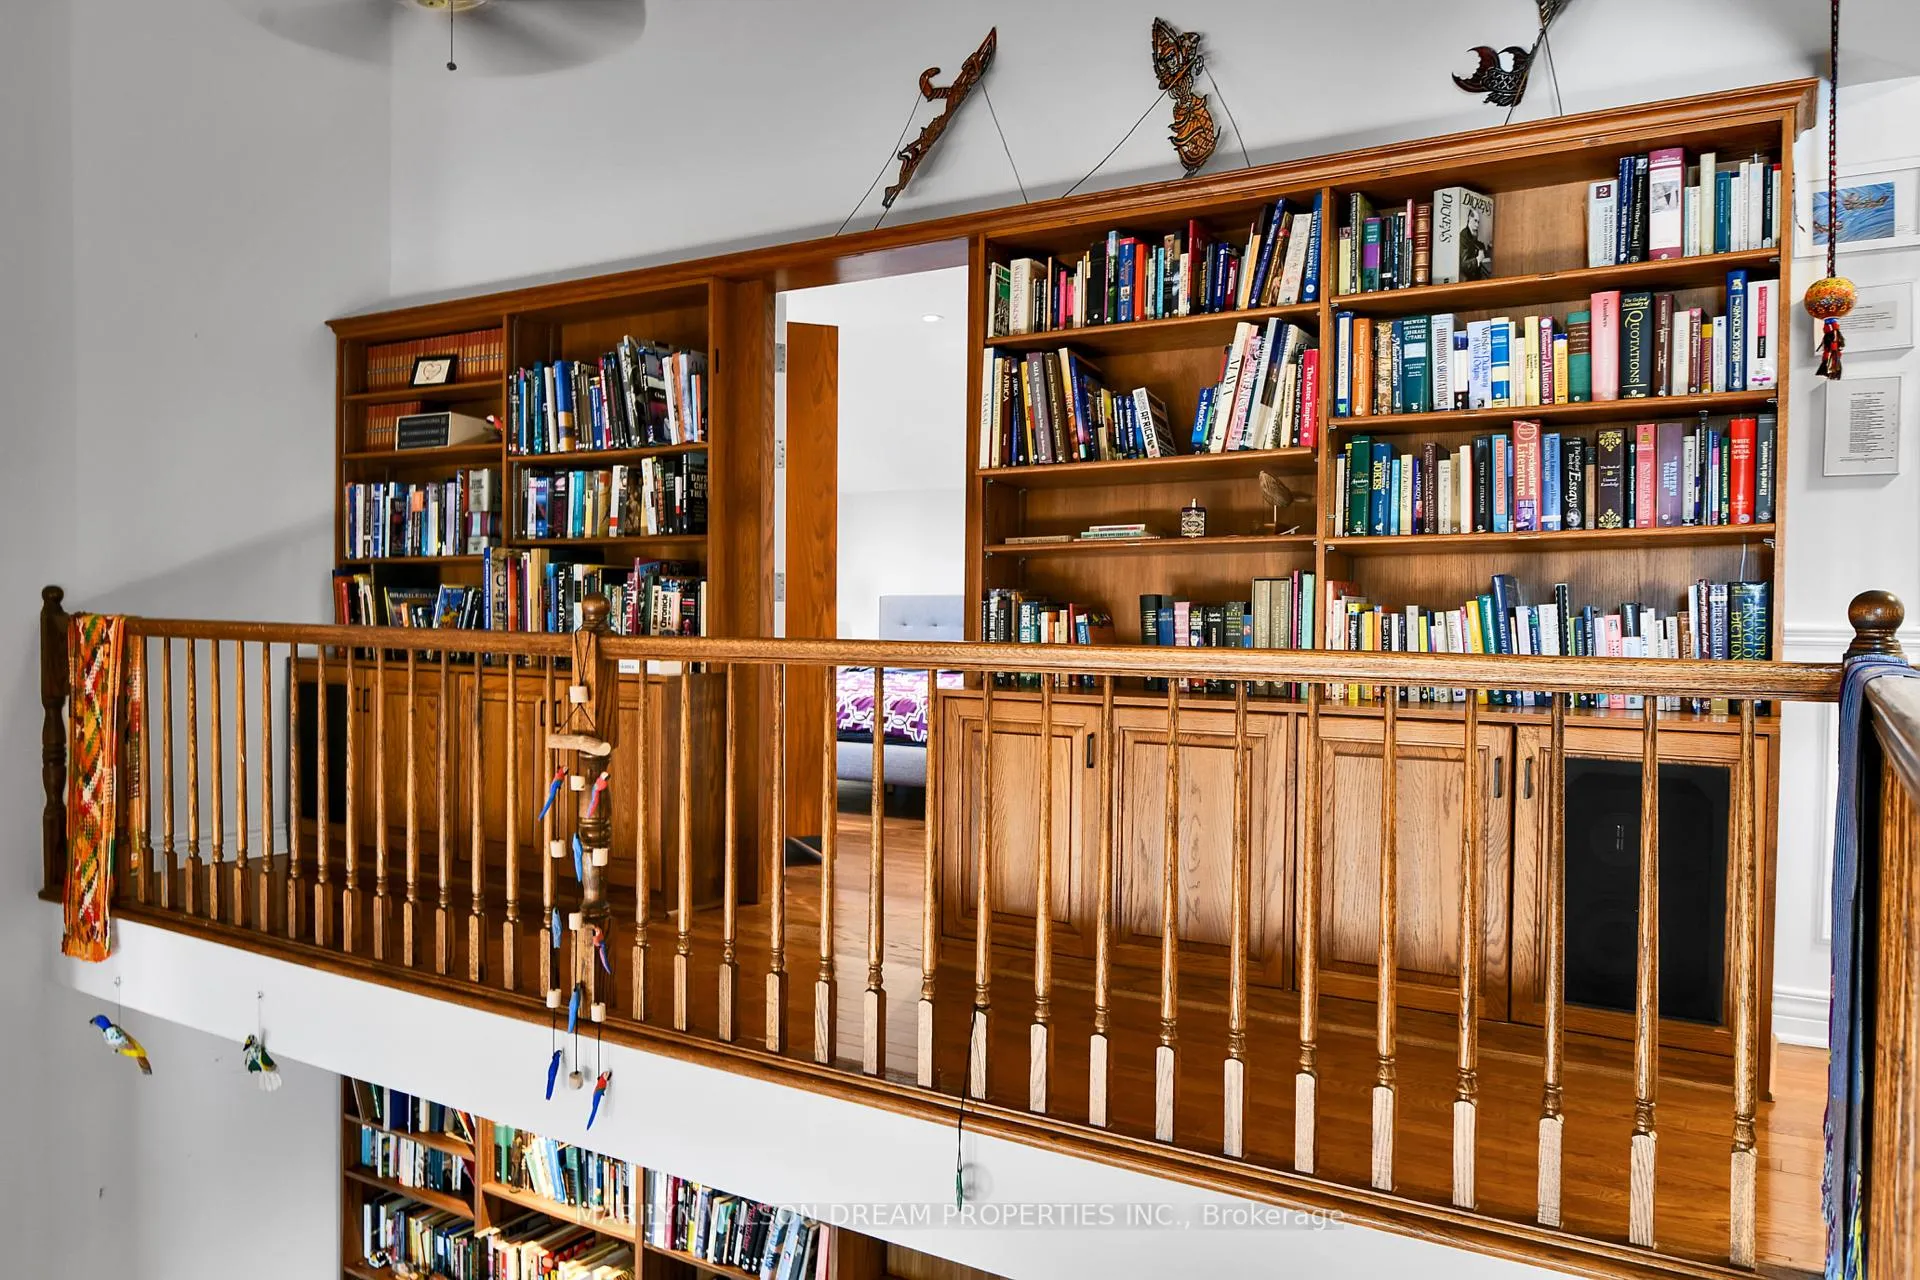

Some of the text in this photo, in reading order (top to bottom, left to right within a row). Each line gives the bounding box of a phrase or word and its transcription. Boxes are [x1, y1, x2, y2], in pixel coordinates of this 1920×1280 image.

[1463, 193, 1492, 217] DICKENS
[1600, 187, 1608, 197] 2
[1439, 193, 1453, 243] DICKENS
[1306, 210, 1318, 279] WILLIAM SHAKESPEARE
[1732, 305, 1741, 339] DICTIONARY
[1625, 310, 1644, 382] QUOTATIONS
[1222, 360, 1239, 396] MAYA
[1436, 328, 1448, 406] HUMOROUS QUOTATIONS
[1542, 360, 1552, 396] Allusions
[1557, 352, 1566, 392] Thesaurus
[1066, 392, 1074, 418] AFRICA
[1304, 366, 1314, 428] The Aztec Empire
[1140, 411, 1153, 440] AFRICA
[1196, 402, 1208, 432] Mexico
[1373, 461, 1382, 490] JOKES
[1517, 443, 1528, 496] Literature
[1528, 442, 1536, 486] Encyclopedia
[1565, 472, 1581, 508] Essays
[557, 585, 565, 602] Age
[558, 569, 566, 585] The
[660, 594, 668, 628] Chronicle
[1021, 605, 1030, 628] SCIENCE
[1714, 604, 1724, 617] THE
[1498, 623, 1506, 639] ATLAS
[1714, 618, 1724, 646] ENGLISH
